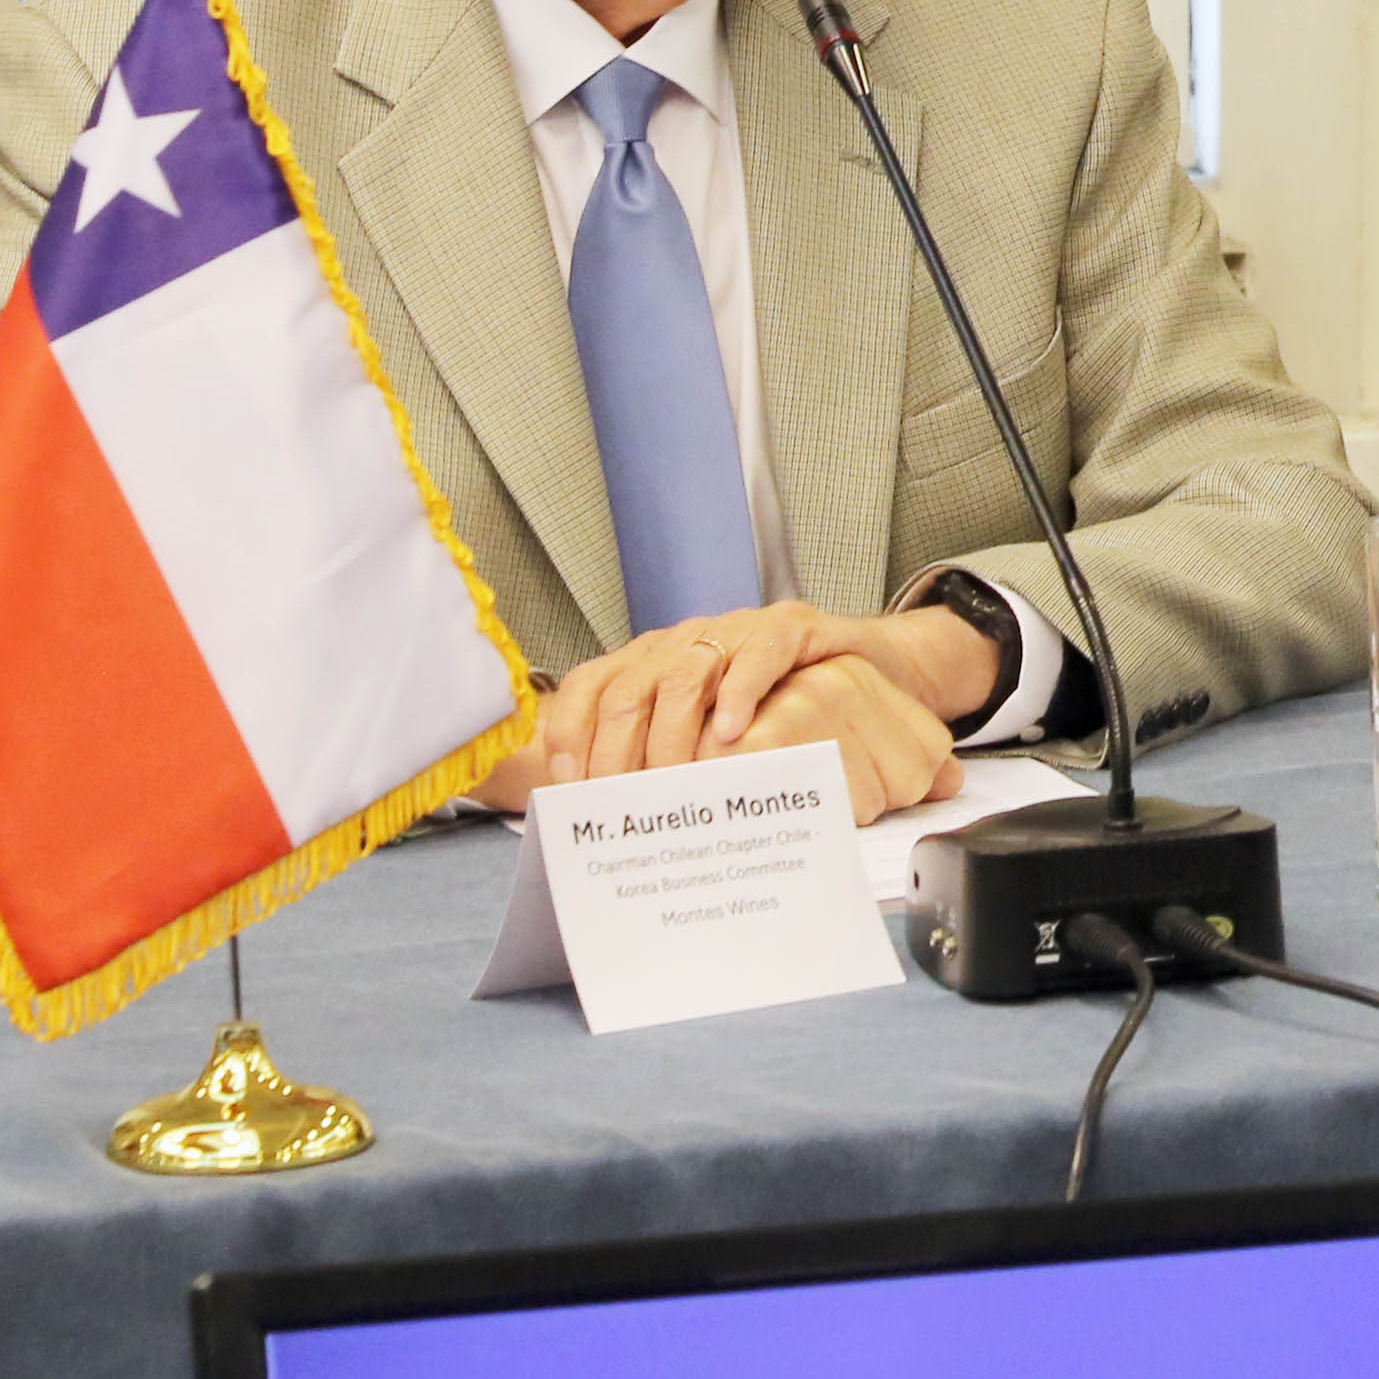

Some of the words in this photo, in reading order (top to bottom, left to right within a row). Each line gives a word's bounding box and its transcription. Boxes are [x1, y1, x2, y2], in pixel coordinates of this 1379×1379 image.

[572, 820, 615, 845] Mr.
[622, 802, 713, 837] Aurelio
[726, 788, 821, 821] Montes
[587, 853, 657, 877] Chairman
[660, 844, 713, 865] Chilean
[716, 834, 773, 857] Chapter
[776, 828, 811, 846] Chile
[616, 880, 658, 899] Korea
[662, 870, 724, 893] Business
[726, 857, 806, 882] Committee
[661, 901, 724, 927] Montes
[728, 895, 780, 917] Wines
